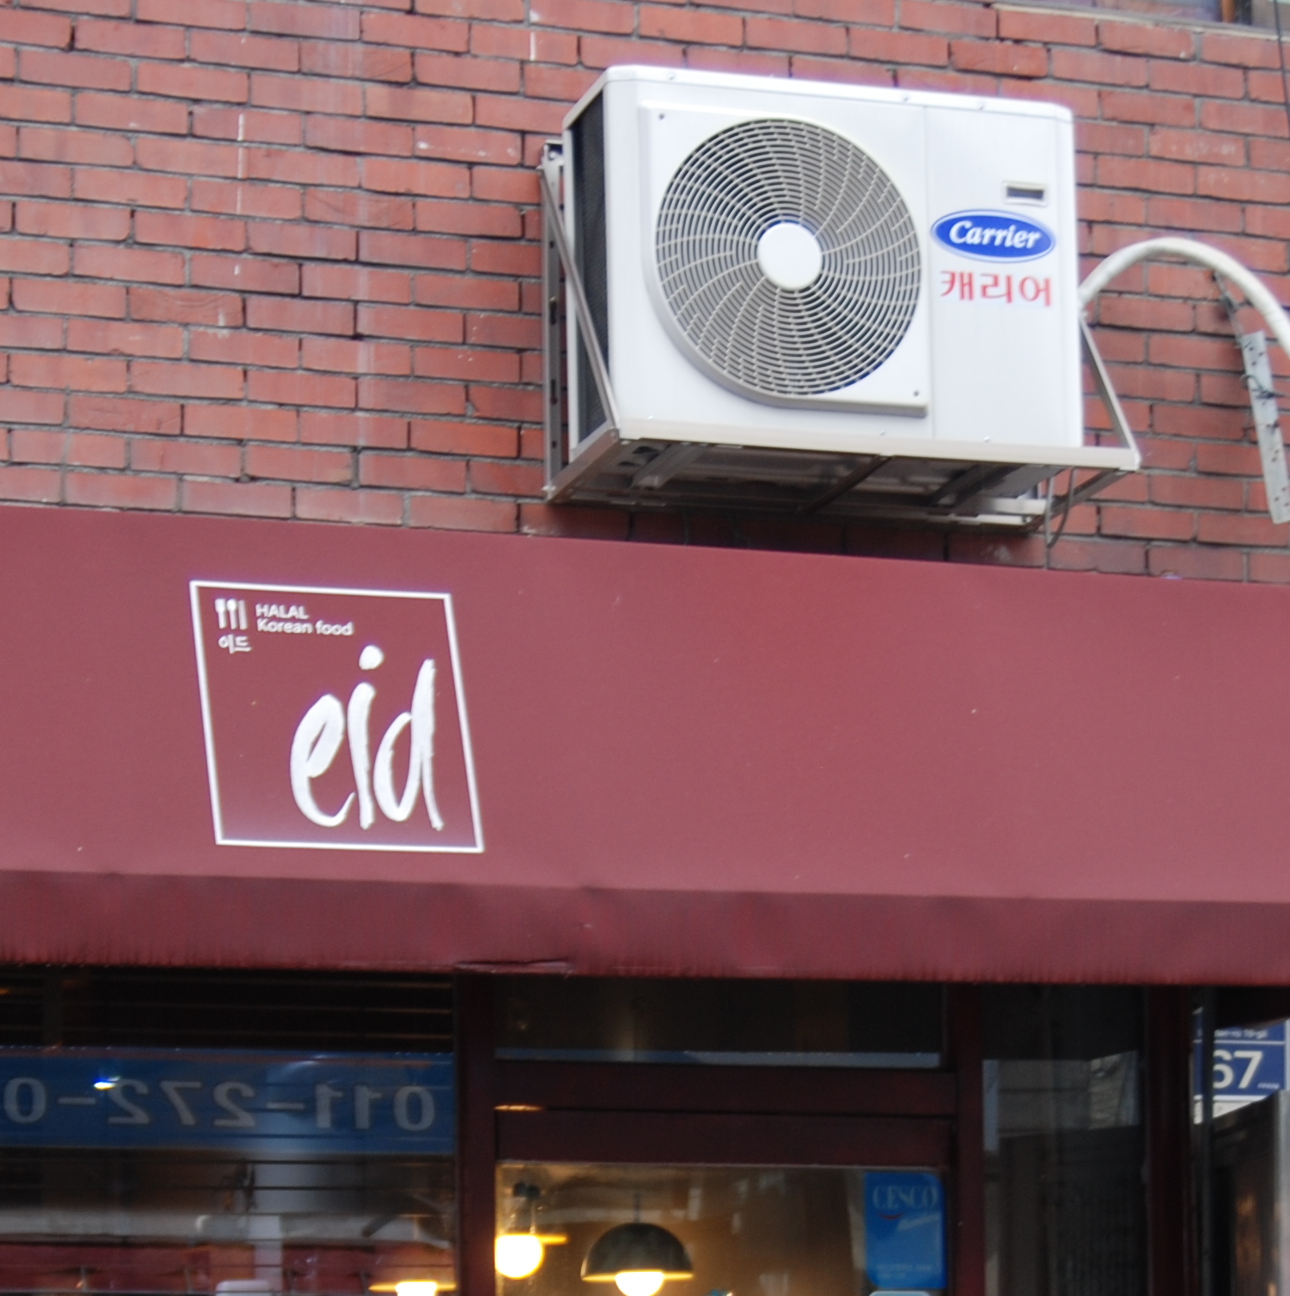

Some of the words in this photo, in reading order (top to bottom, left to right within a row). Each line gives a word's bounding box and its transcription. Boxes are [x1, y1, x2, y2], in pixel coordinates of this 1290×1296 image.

[949, 220, 1042, 249] Carrier
[938, 270, 1053, 307] 캐리어
[255, 603, 309, 620] HALAL
[256, 618, 313, 636] Korean
[315, 620, 355, 638] food
[217, 633, 252, 654] 이드
[289, 644, 445, 831] eid
[1212, 1049, 1263, 1089] 67
[872, 1184, 939, 1209] CESCO
